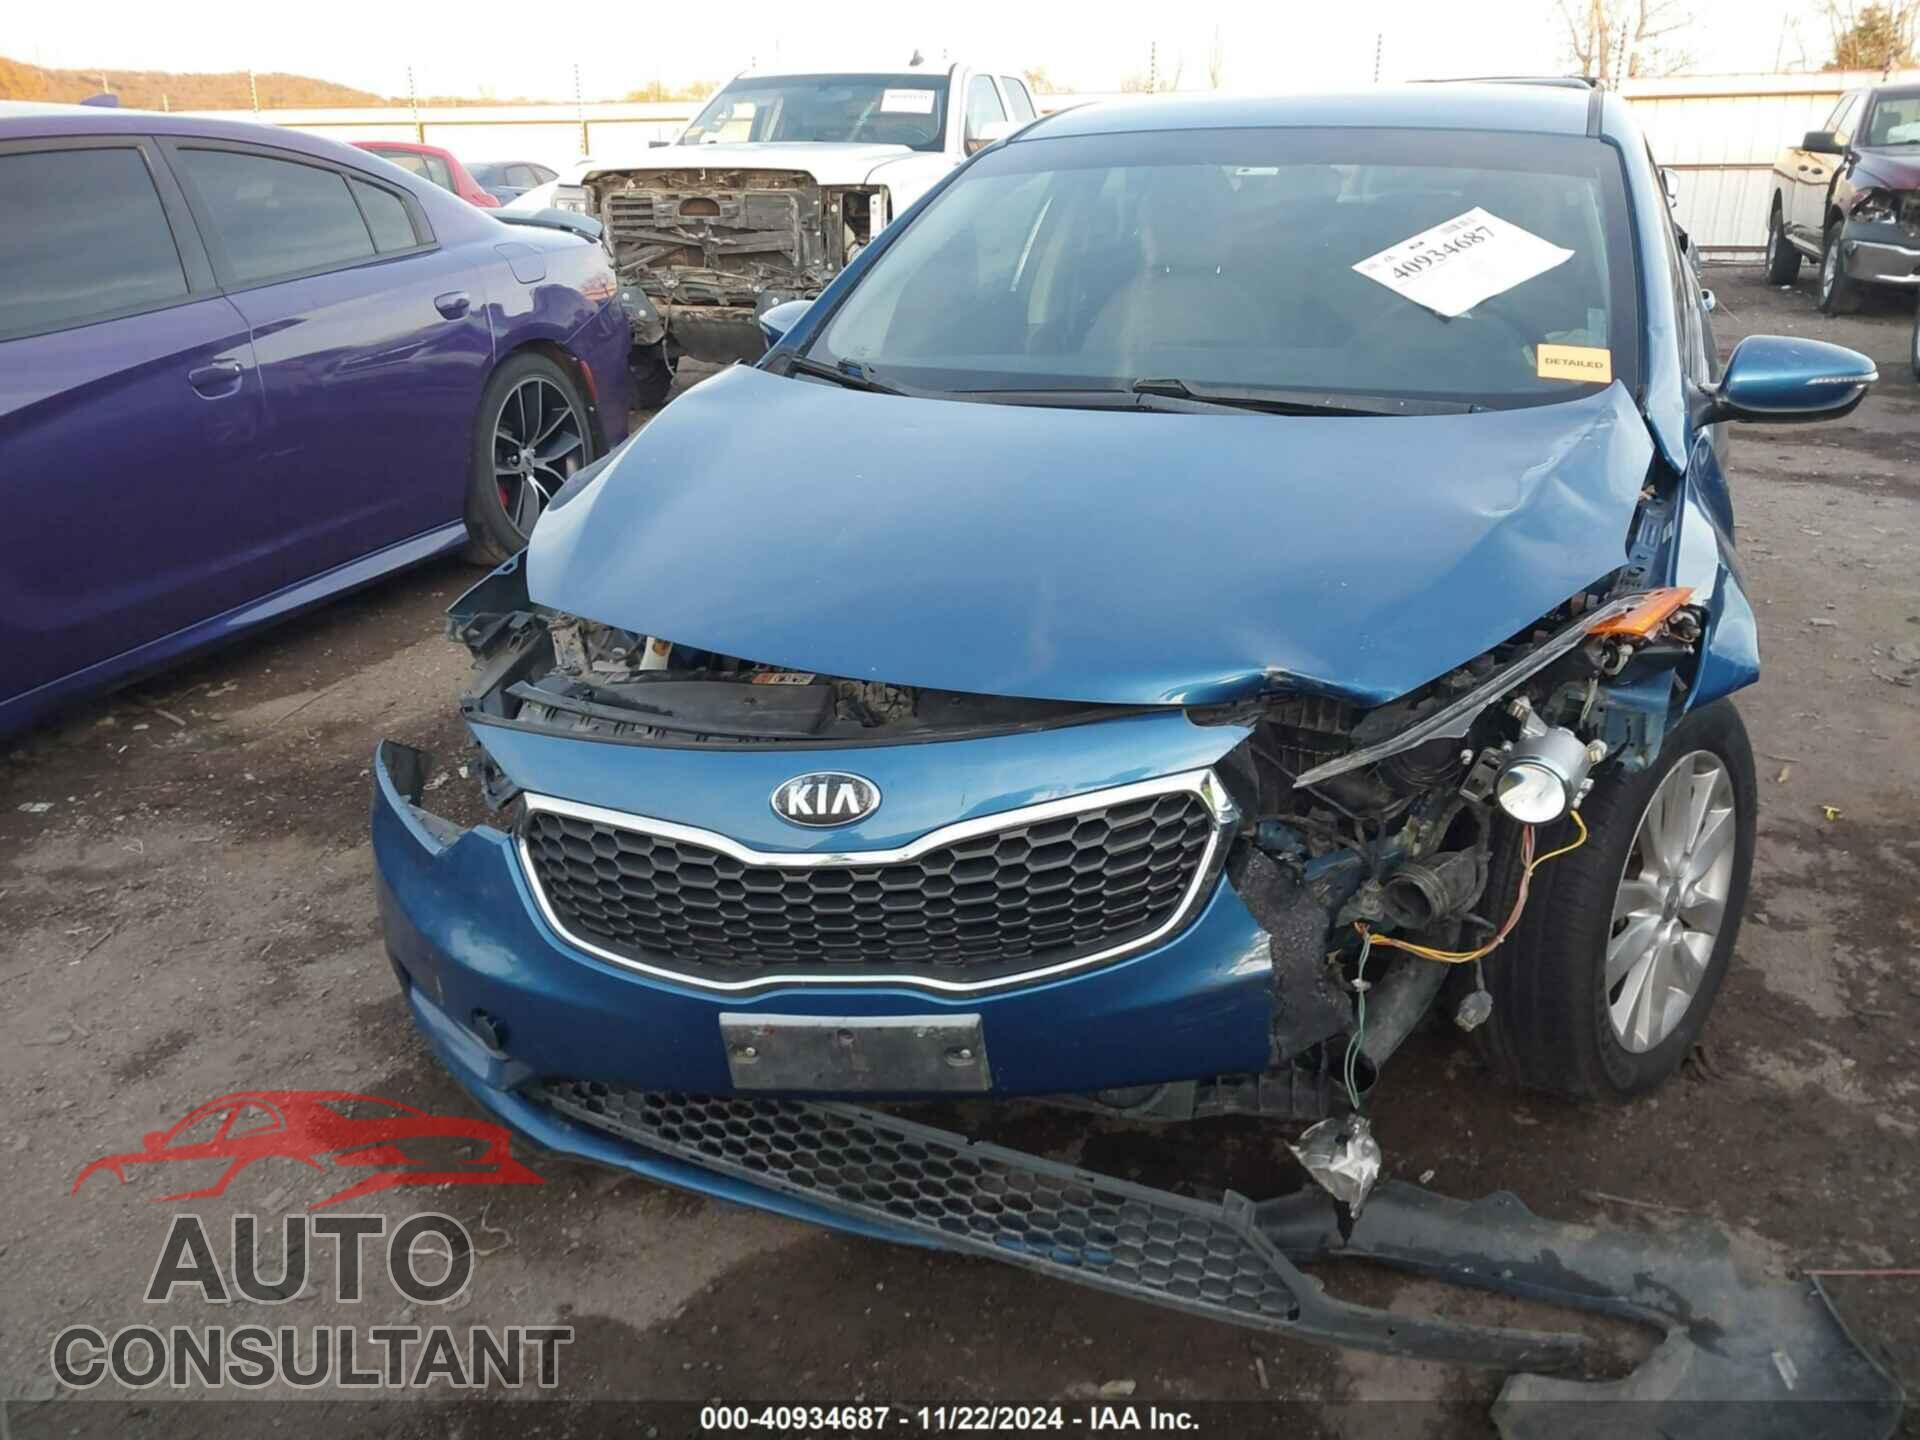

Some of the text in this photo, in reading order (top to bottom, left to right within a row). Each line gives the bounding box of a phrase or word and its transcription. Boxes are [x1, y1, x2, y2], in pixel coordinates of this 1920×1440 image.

[1393, 225, 1495, 279] 40934687
[1545, 358, 1604, 369] DETAILED
[787, 783, 861, 815] KIA
